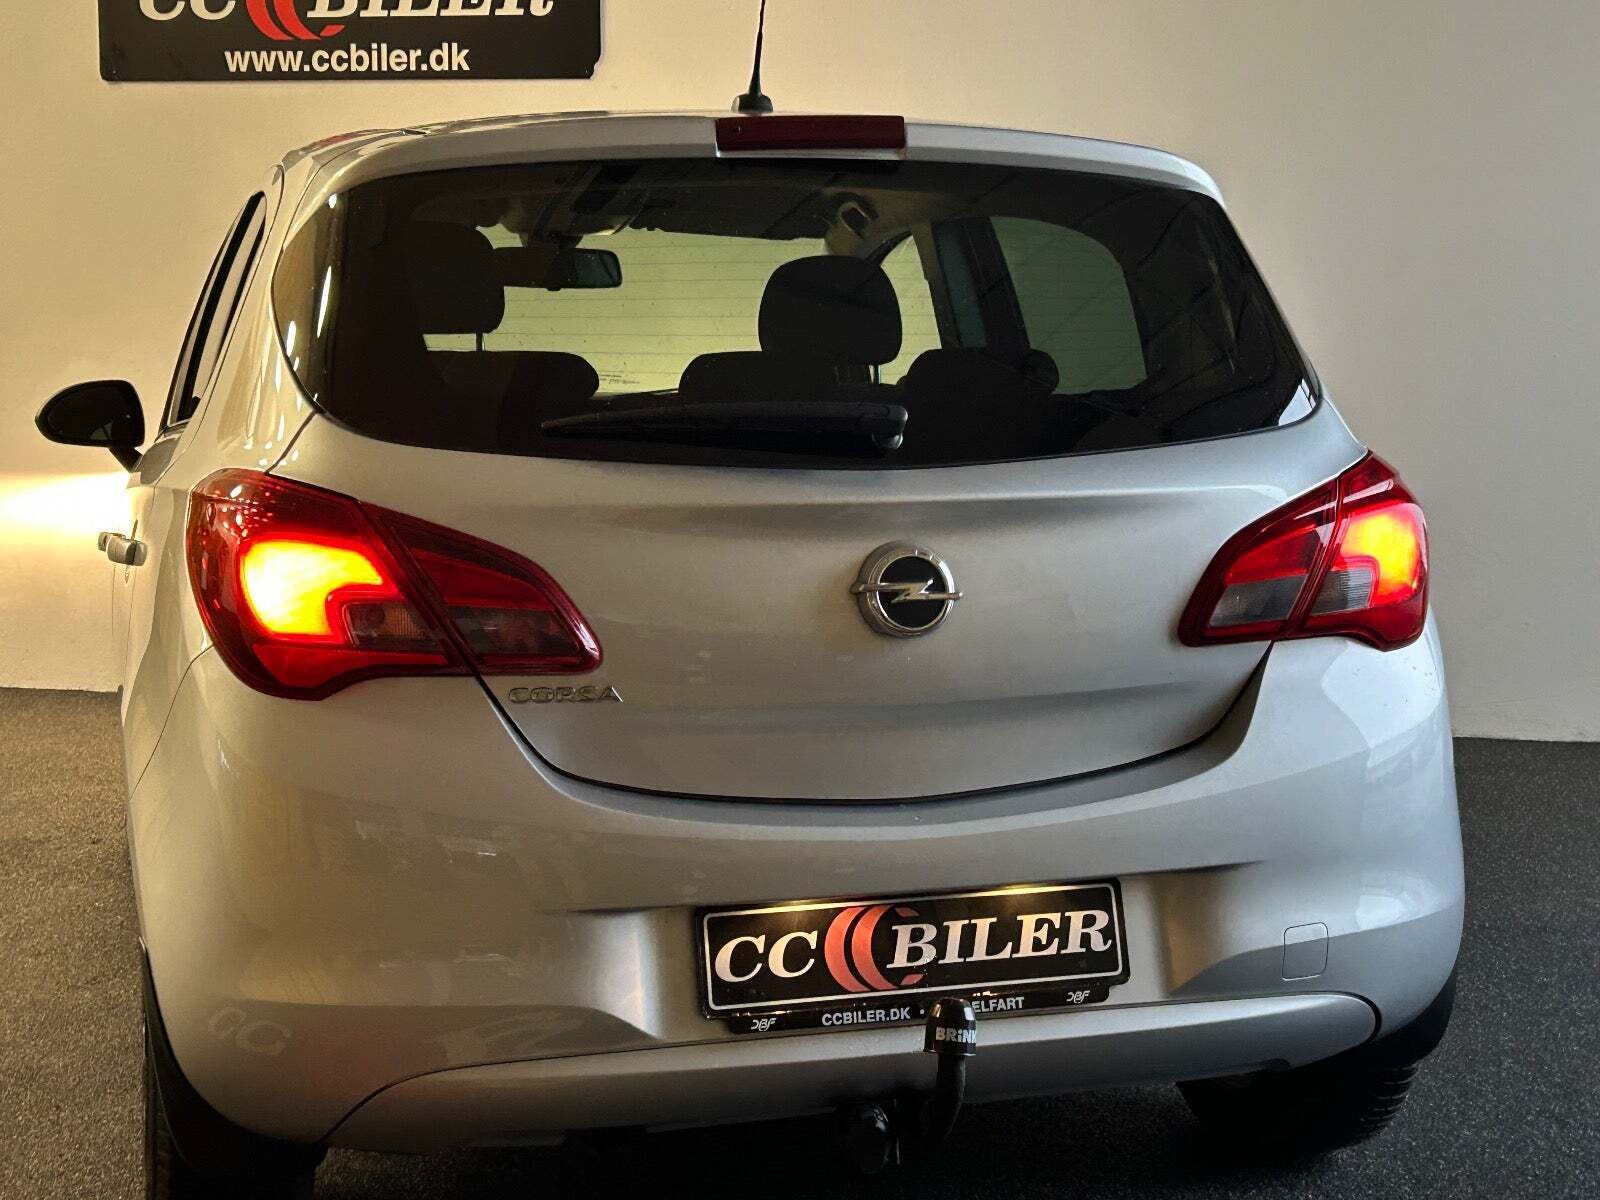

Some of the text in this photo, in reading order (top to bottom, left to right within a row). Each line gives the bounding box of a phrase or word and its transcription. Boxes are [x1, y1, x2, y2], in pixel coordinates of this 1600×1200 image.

[225, 43, 471, 73] www.ccbiler.dk
[508, 686, 624, 704] CORSA
[714, 908, 1112, 984] CC BILER
[821, 996, 1025, 1026] CCBILER.DK ELFART
